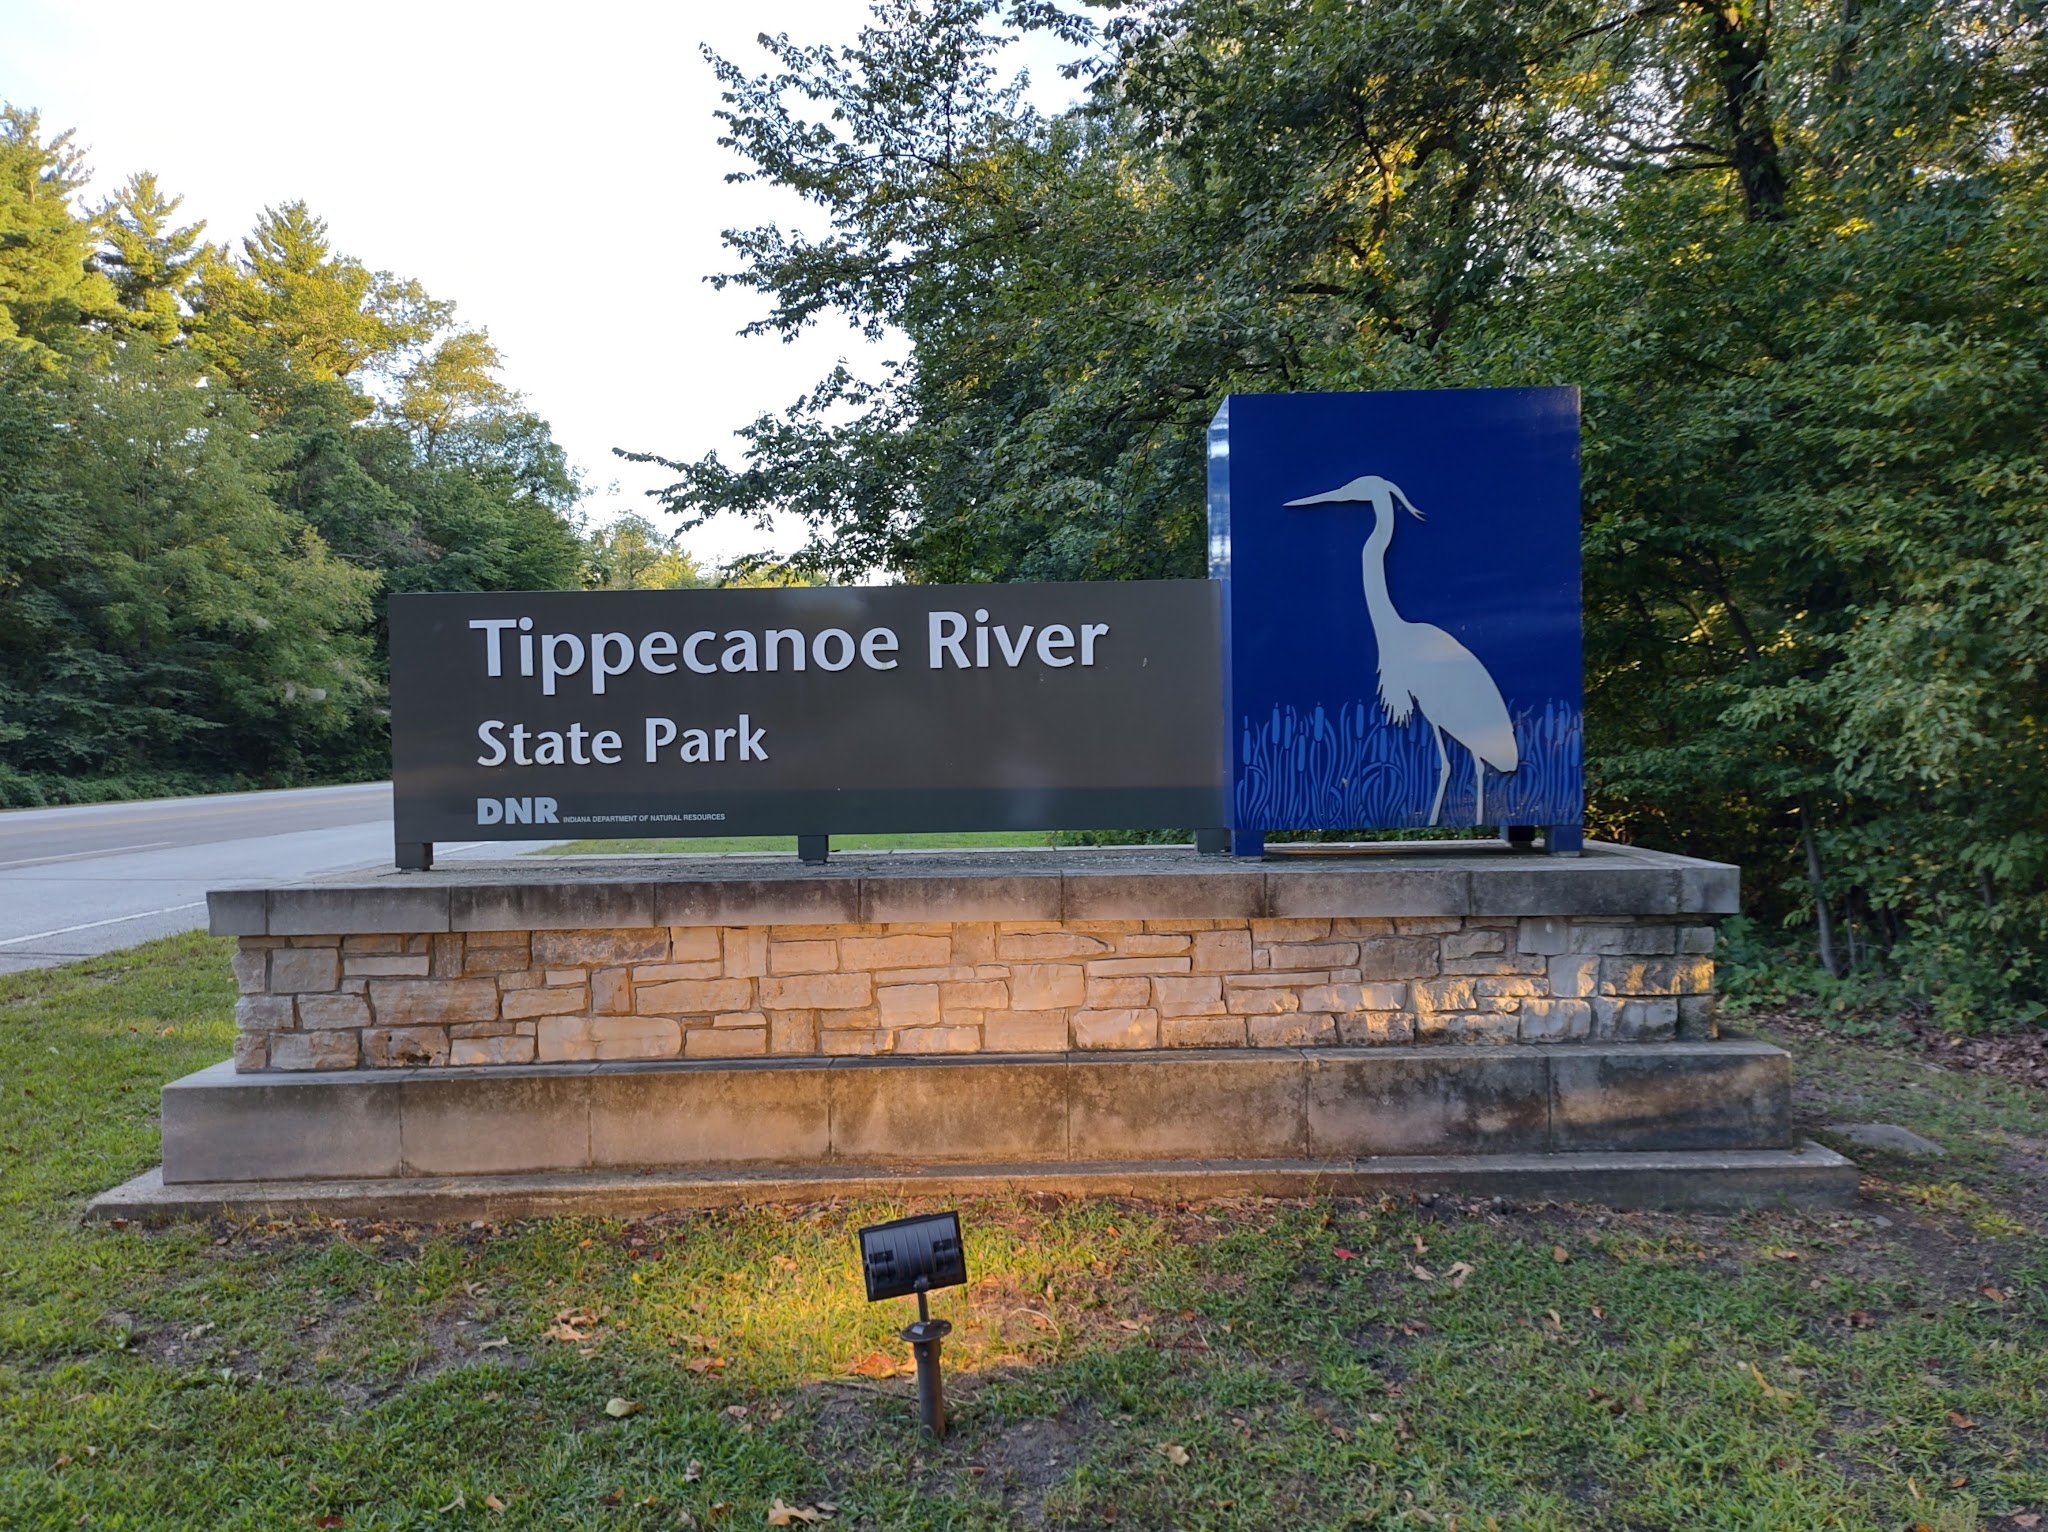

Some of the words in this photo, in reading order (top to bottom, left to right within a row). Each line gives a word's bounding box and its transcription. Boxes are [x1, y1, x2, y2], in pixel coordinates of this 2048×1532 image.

[468, 616, 900, 697] Tippecanoe
[928, 608, 1110, 669] River
[477, 719, 623, 768] State
[645, 713, 769, 764] Park
[476, 797, 560, 825] DNR
[563, 815, 591, 823] INDIANA
[592, 814, 638, 823] DEPARTMENT
[638, 814, 649, 822] OF
[650, 814, 682, 822] NATURAL
[683, 813, 726, 821] RESOURCES
